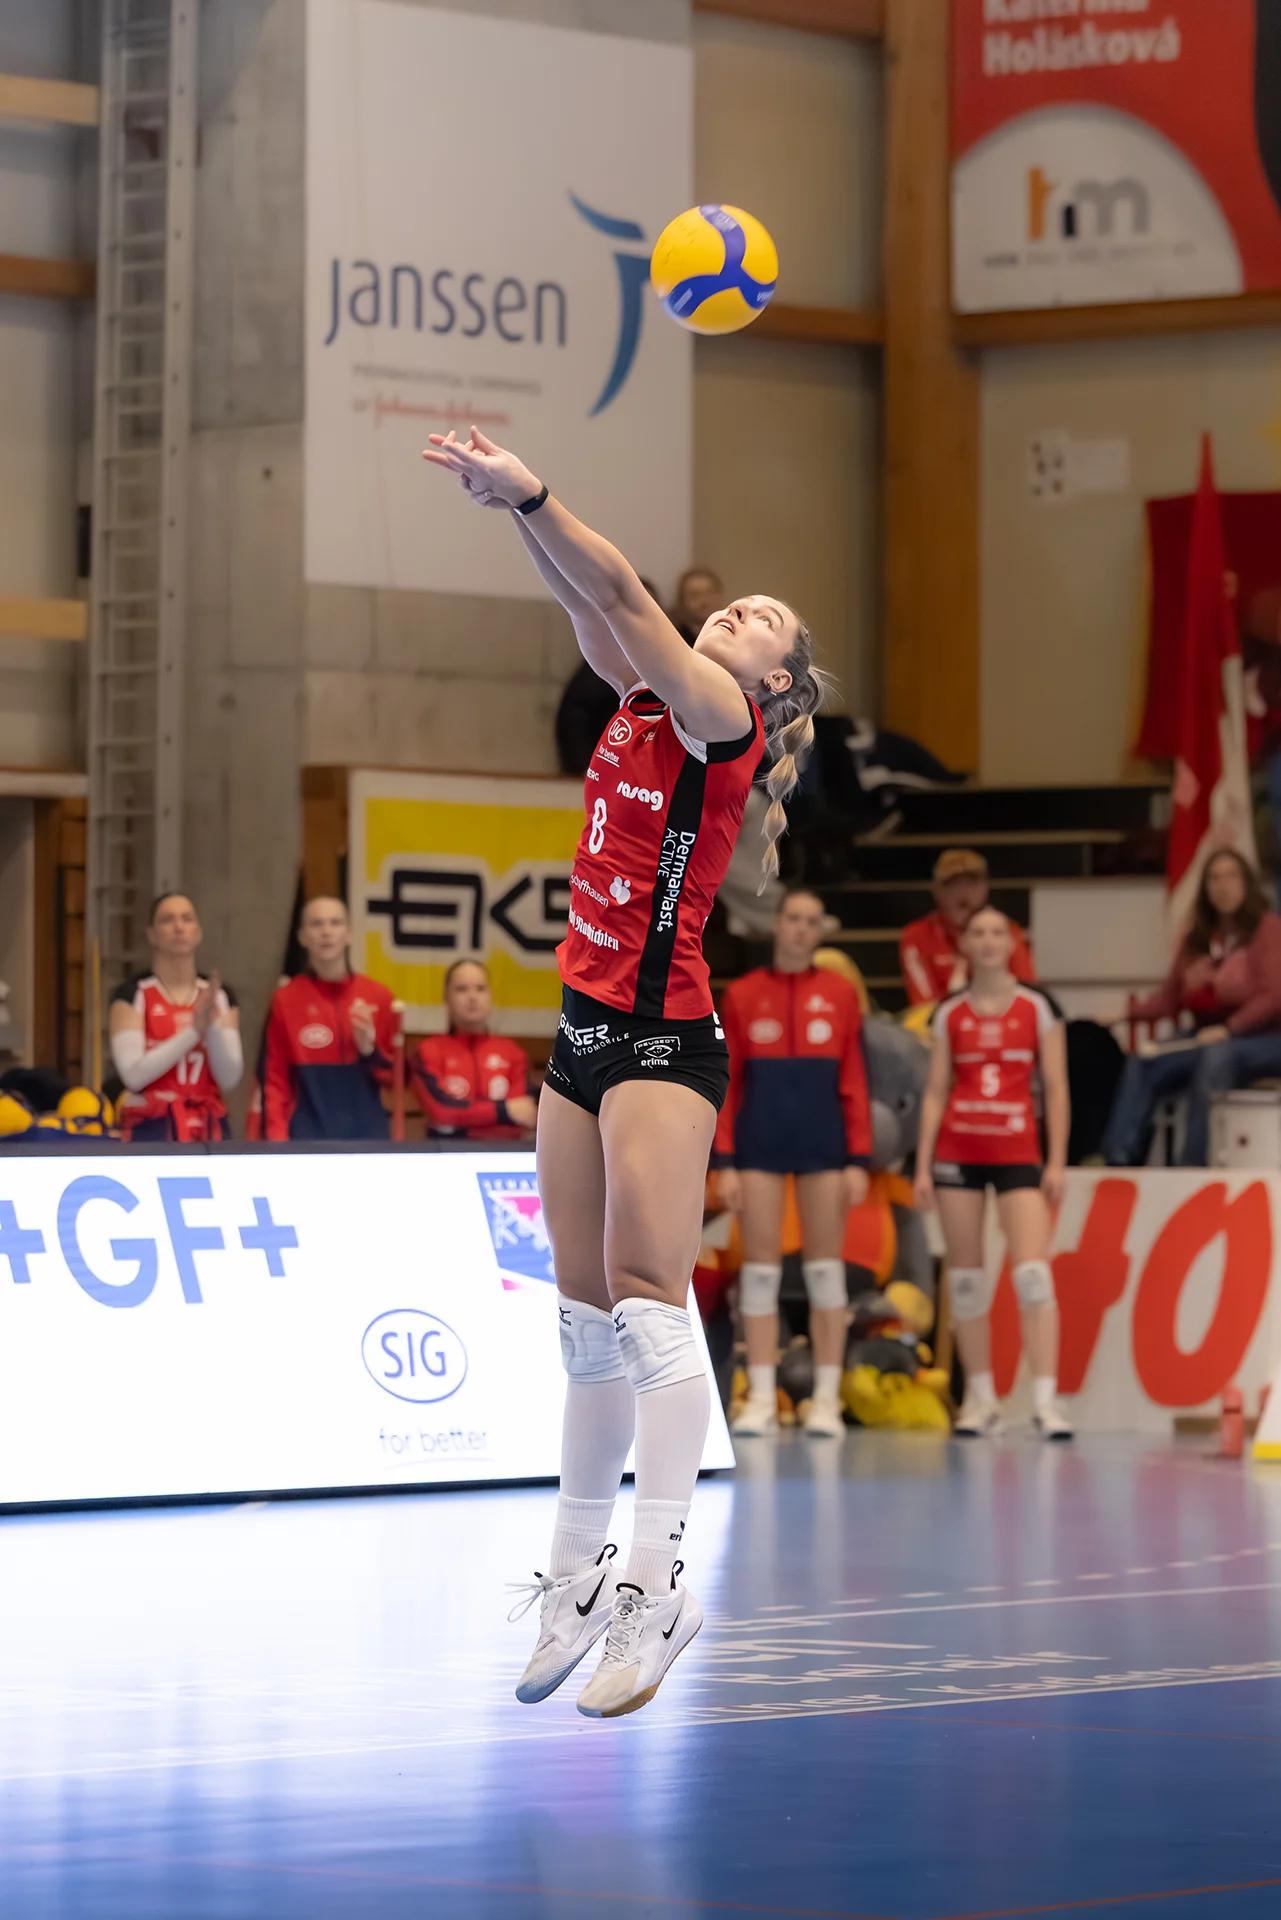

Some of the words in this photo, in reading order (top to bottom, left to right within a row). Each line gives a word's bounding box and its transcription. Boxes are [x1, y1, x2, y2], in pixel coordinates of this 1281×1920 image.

[324, 259, 566, 347] Janssen
[617, 781, 664, 811] rasag
[589, 797, 607, 854] 8
[657, 828, 678, 878] ACTIVE
[637, 1039, 676, 1048] PEUGEOT
[177, 1052, 205, 1085] 17
[641, 1058, 669, 1068] erima
[981, 1063, 1000, 1097] 5
[381, 1330, 447, 1378] SIG
[379, 1427, 411, 1454] for
[418, 1425, 488, 1452] better
[669, 1532, 682, 1542] eri
